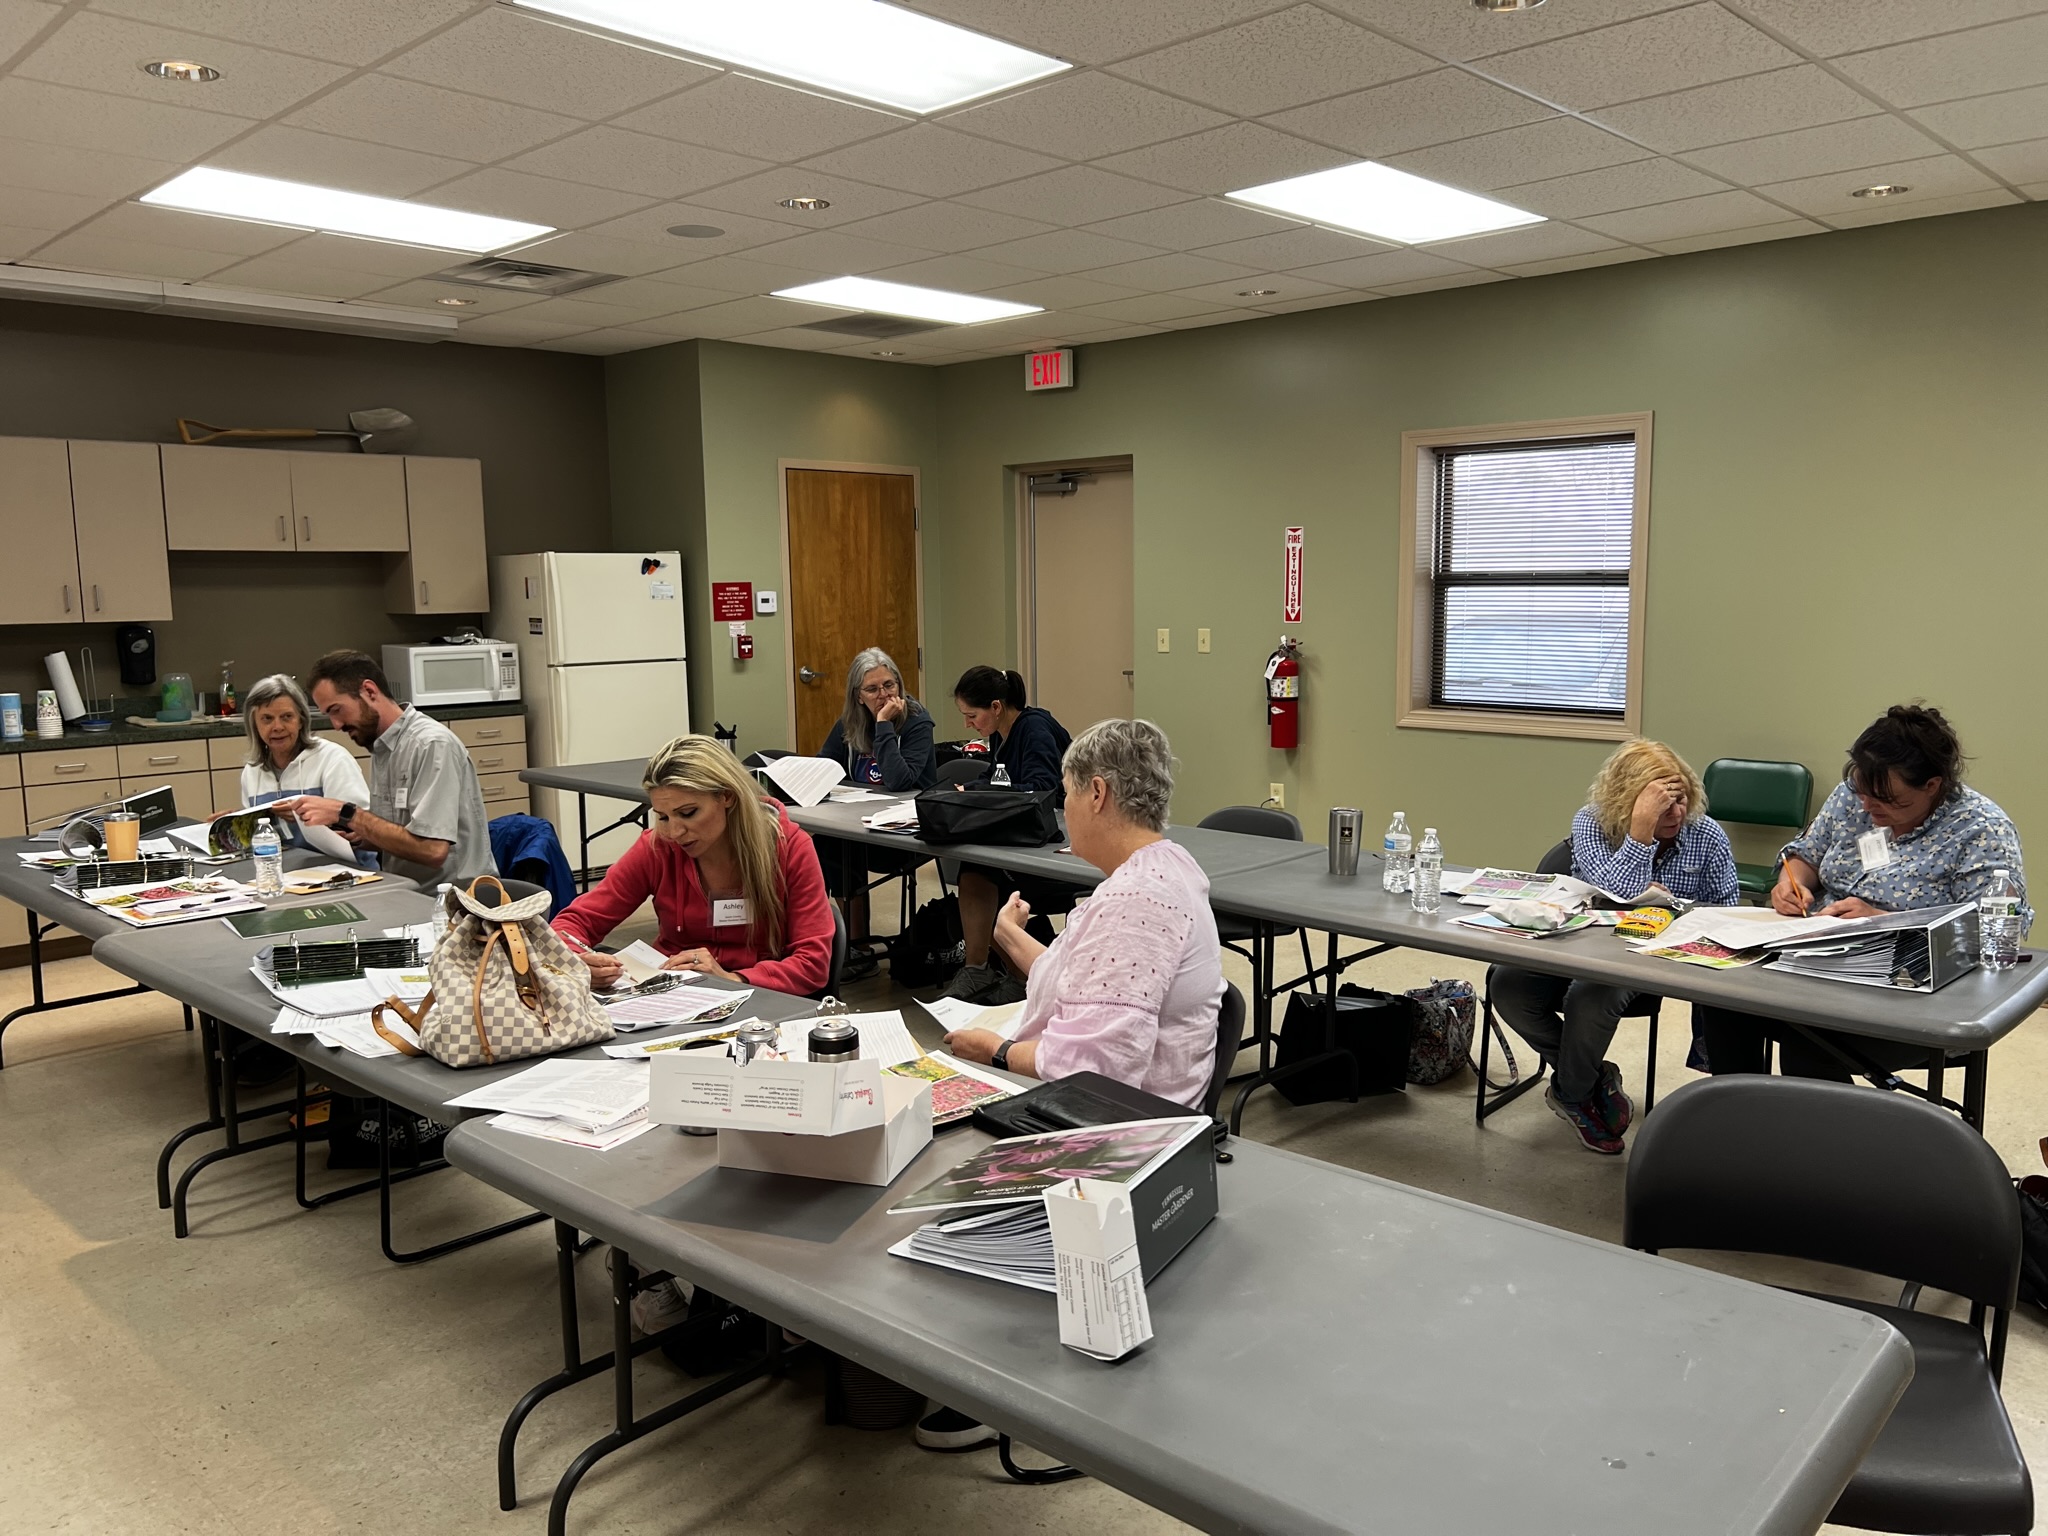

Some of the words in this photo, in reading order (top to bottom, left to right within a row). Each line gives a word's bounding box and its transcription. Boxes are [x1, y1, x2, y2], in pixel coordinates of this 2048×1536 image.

[1032, 352, 1062, 386] EXIT
[1288, 534, 1301, 544] FIRE
[1151, 1209, 1171, 1232] MASTER
